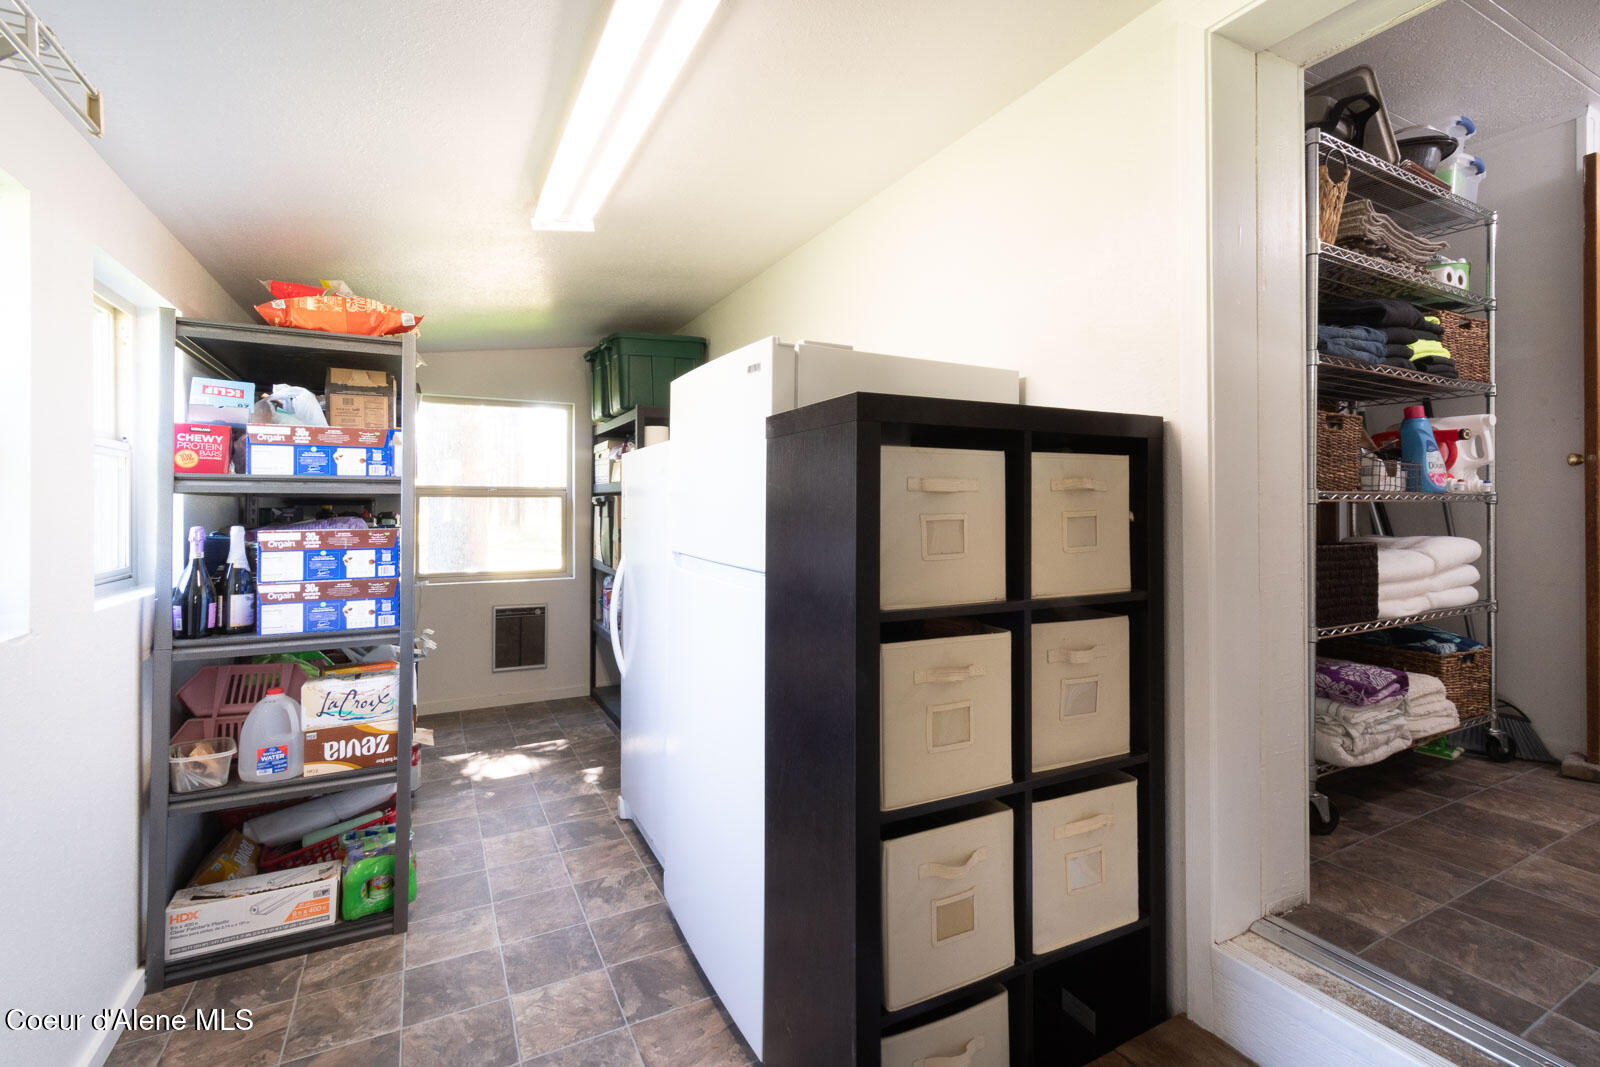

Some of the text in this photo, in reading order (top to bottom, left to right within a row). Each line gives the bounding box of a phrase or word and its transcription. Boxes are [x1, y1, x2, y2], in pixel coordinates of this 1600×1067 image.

[176, 432, 223, 443] CHEWY
[257, 432, 285, 442] Orgain
[176, 441, 223, 450] PROTEIN
[199, 449, 223, 457] BARS
[267, 540, 296, 549] Orgain
[267, 591, 296, 601] Orgain
[323, 734, 390, 761] zevia
[261, 753, 285, 761] WATER
[169, 911, 200, 925] HDX
